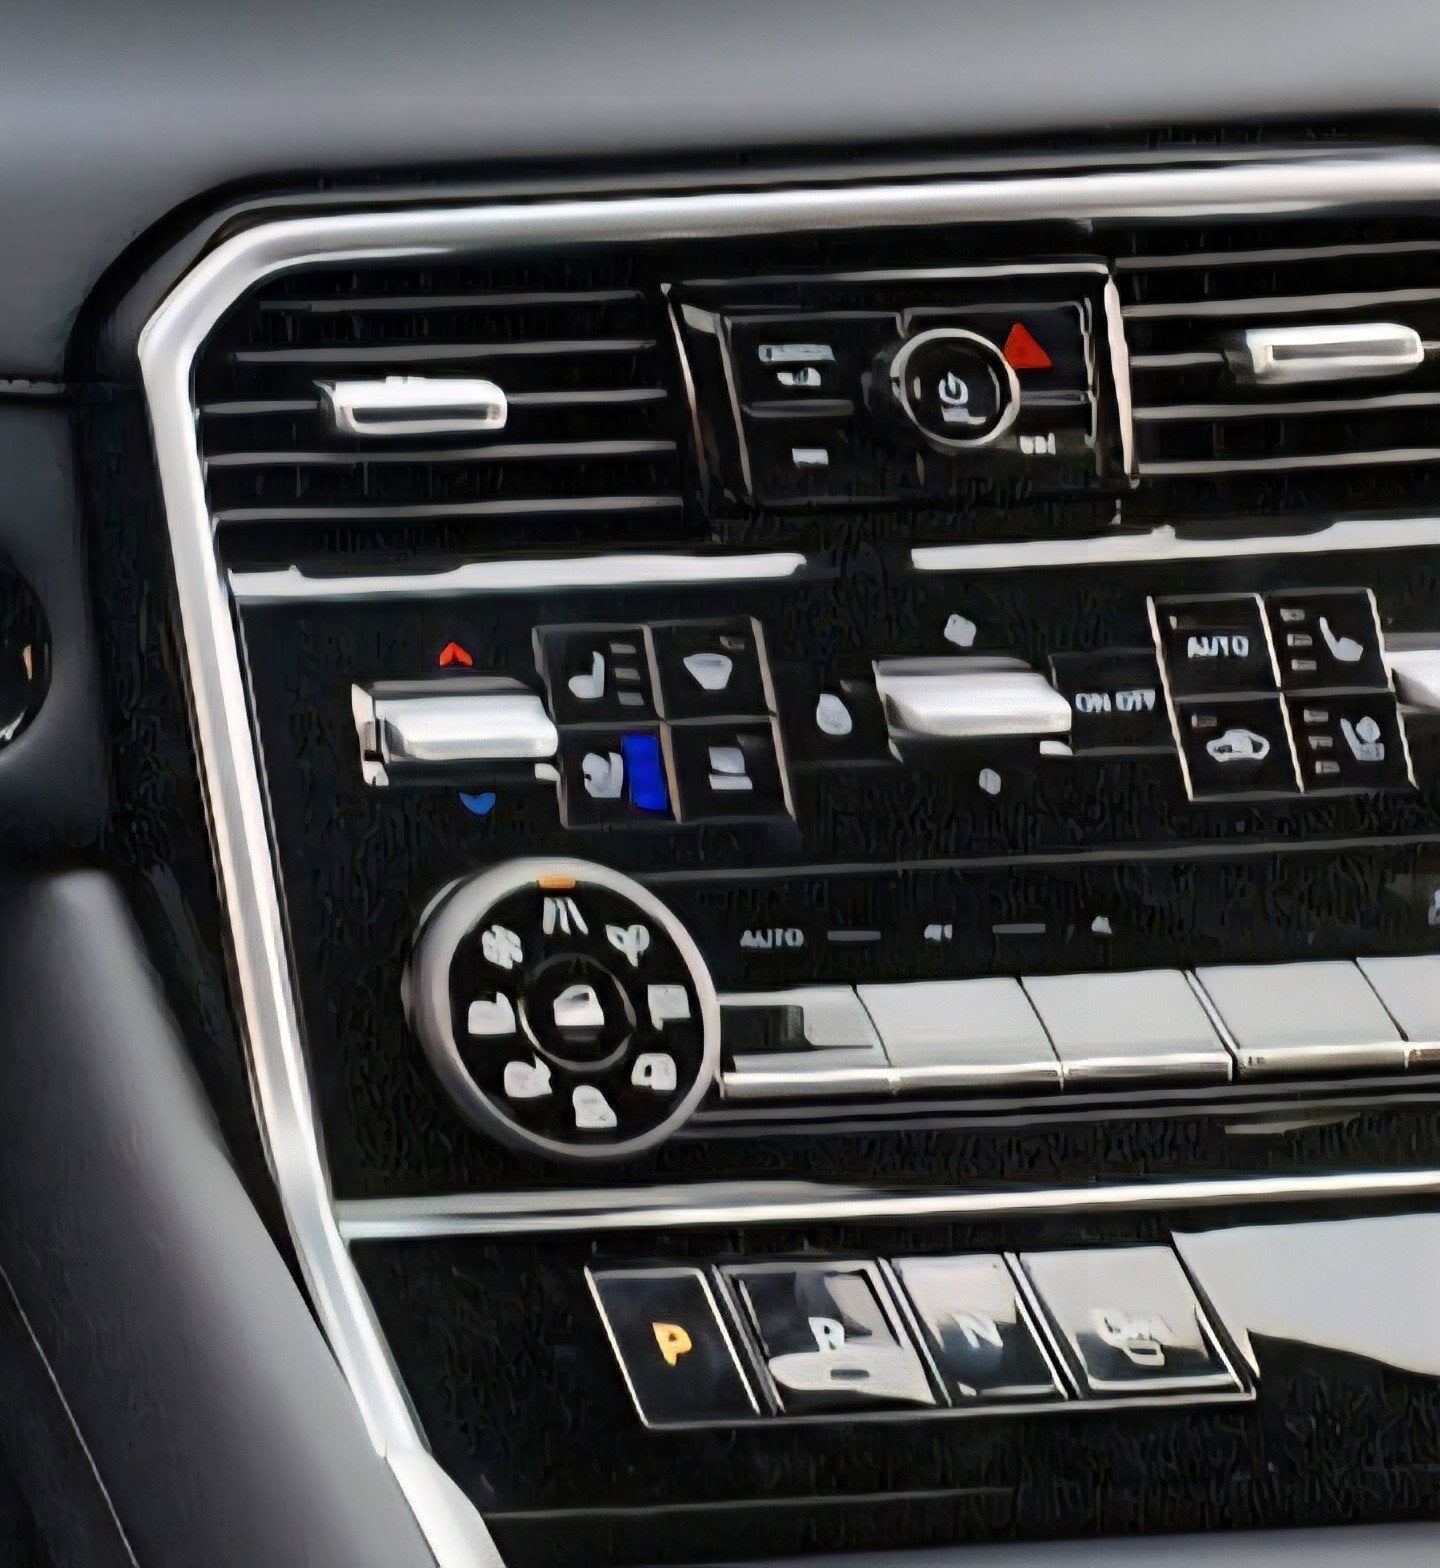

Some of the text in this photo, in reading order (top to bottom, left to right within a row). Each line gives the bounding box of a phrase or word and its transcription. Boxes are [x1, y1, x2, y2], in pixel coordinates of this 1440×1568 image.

[1187, 635, 1250, 658] AUTO
[652, 1321, 693, 1367] P
[808, 1316, 846, 1353] R
